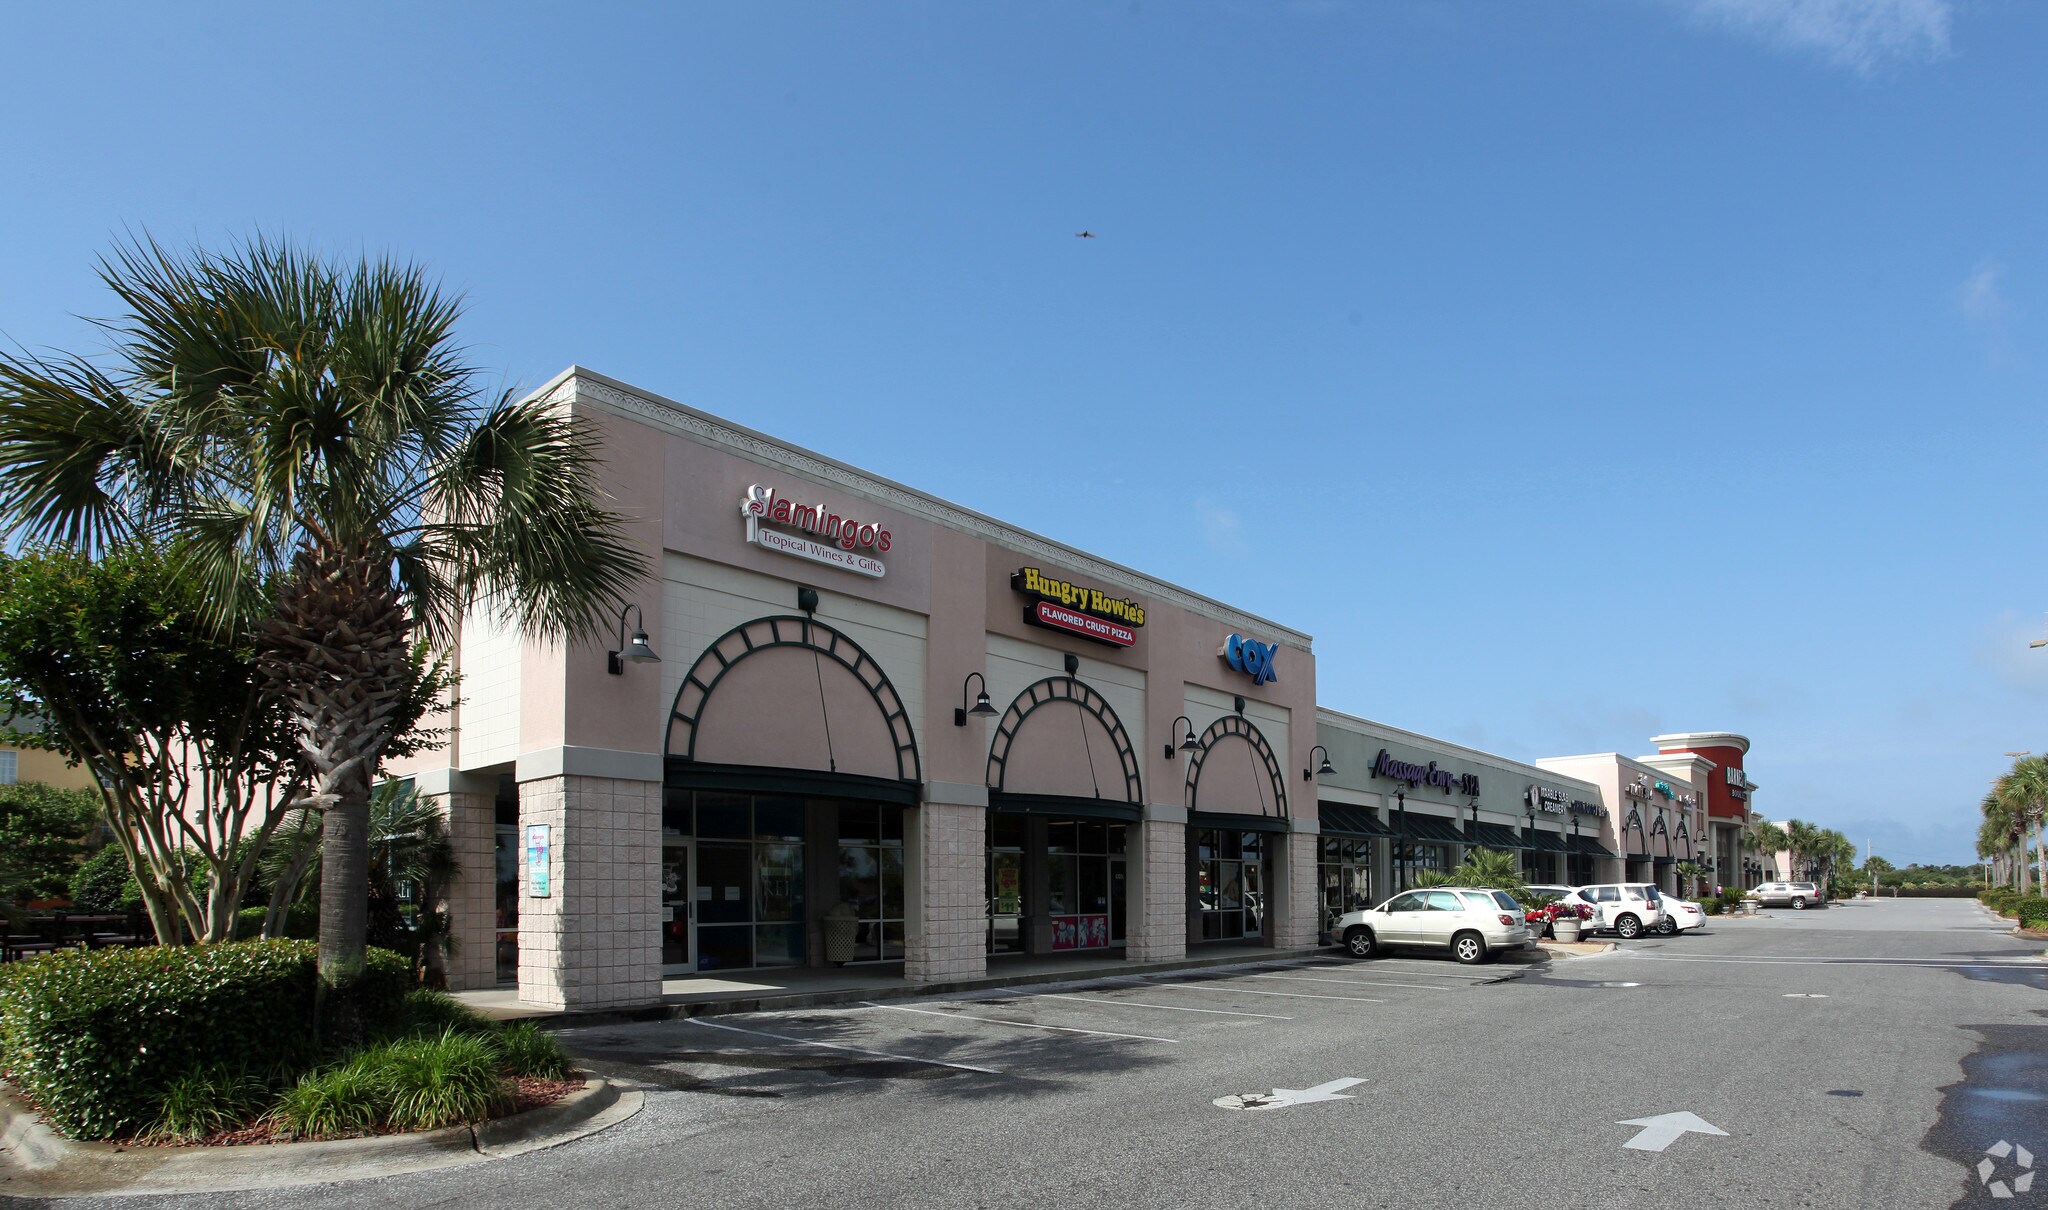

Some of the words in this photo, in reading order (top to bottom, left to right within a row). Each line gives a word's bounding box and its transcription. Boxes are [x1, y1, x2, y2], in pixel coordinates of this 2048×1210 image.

[761, 530, 806, 552] Tropical
[810, 544, 843, 562] Wines
[846, 553, 855, 566] &
[858, 558, 882, 573] Gifts
[1024, 567, 1089, 610] Hungry
[1090, 589, 1145, 626] Howie's
[1041, 606, 1084, 628] FLAVORED
[1085, 618, 1110, 635] CRUST
[1111, 625, 1133, 642] PIZZA
[1373, 749, 1428, 788] Massage
[1427, 761, 1453, 795] Envy
[1462, 773, 1480, 797] SPA
[1540, 786, 1558, 801] MARBLE
[1558, 790, 1569, 803] SLAB
[1544, 800, 1567, 815] CREAMERY
